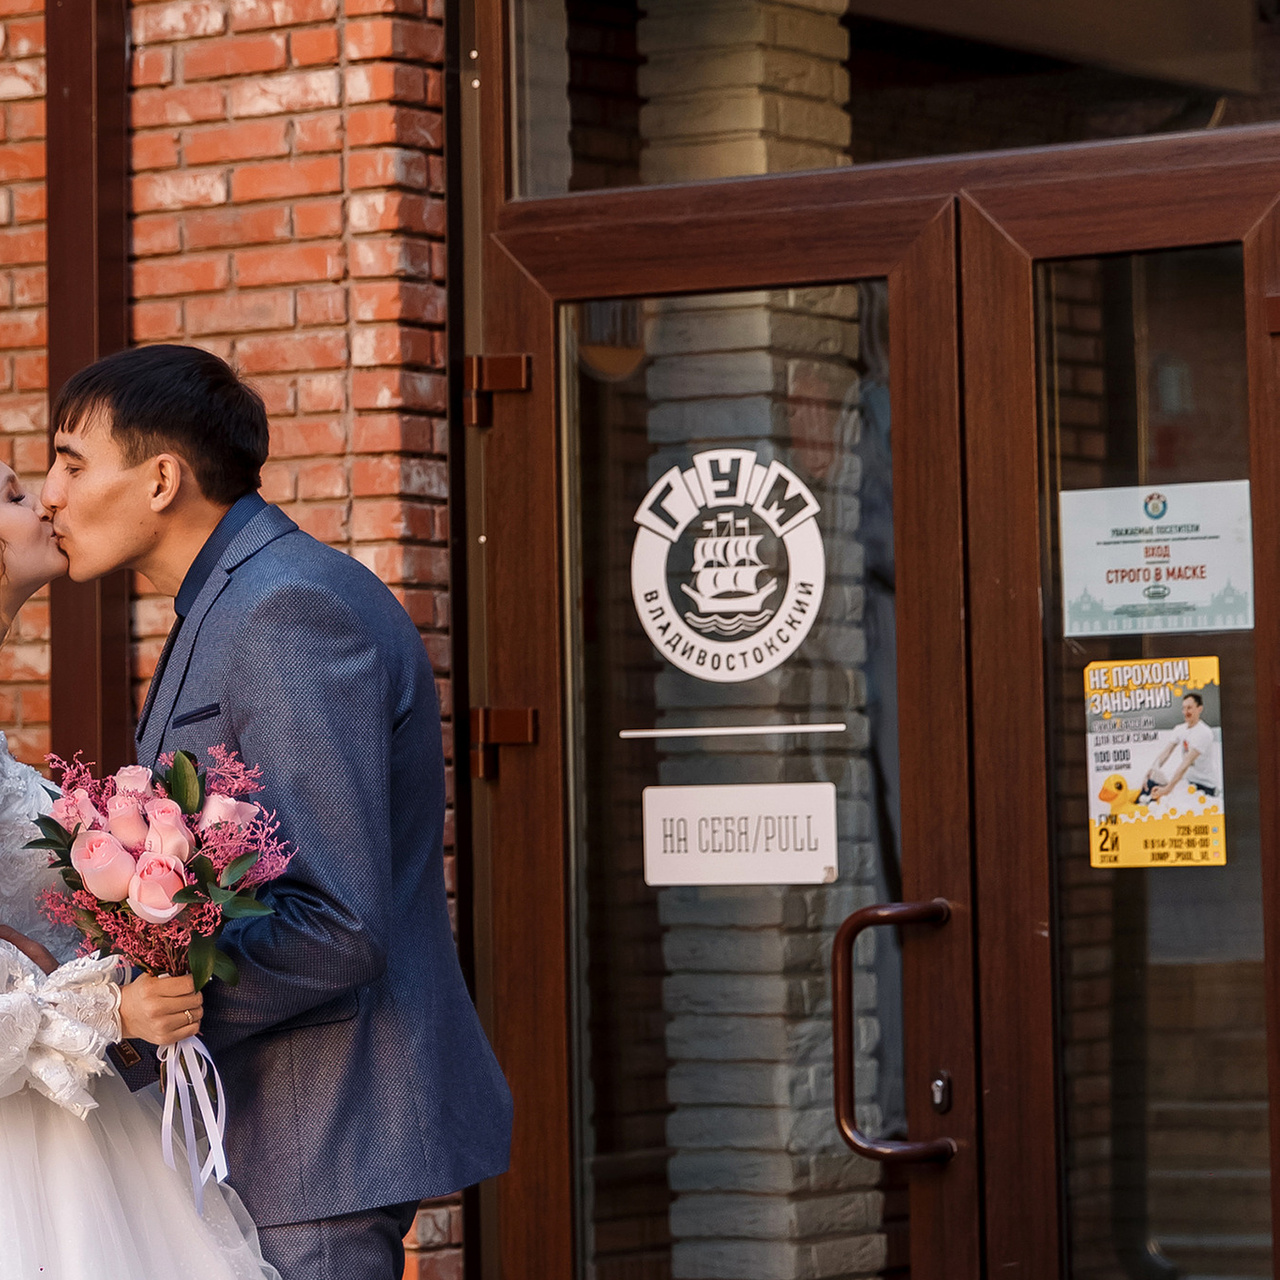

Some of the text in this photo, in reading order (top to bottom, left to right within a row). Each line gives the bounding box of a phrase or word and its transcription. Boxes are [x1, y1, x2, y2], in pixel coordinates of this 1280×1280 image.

[648, 457, 810, 531] ГУМ
[1144, 545, 1170, 558] ВХОД
[1106, 564, 1207, 584] СТРОГО В МАСКЕ
[643, 581, 814, 672] ВЛАДИВОСТОКСКИЙ
[1089, 659, 1190, 690] НЕ ПРОХОДИ!
[1091, 686, 1172, 715] ЗАНЫРНИ!
[662, 815, 819, 853] НА СЕБЯ/PULL
